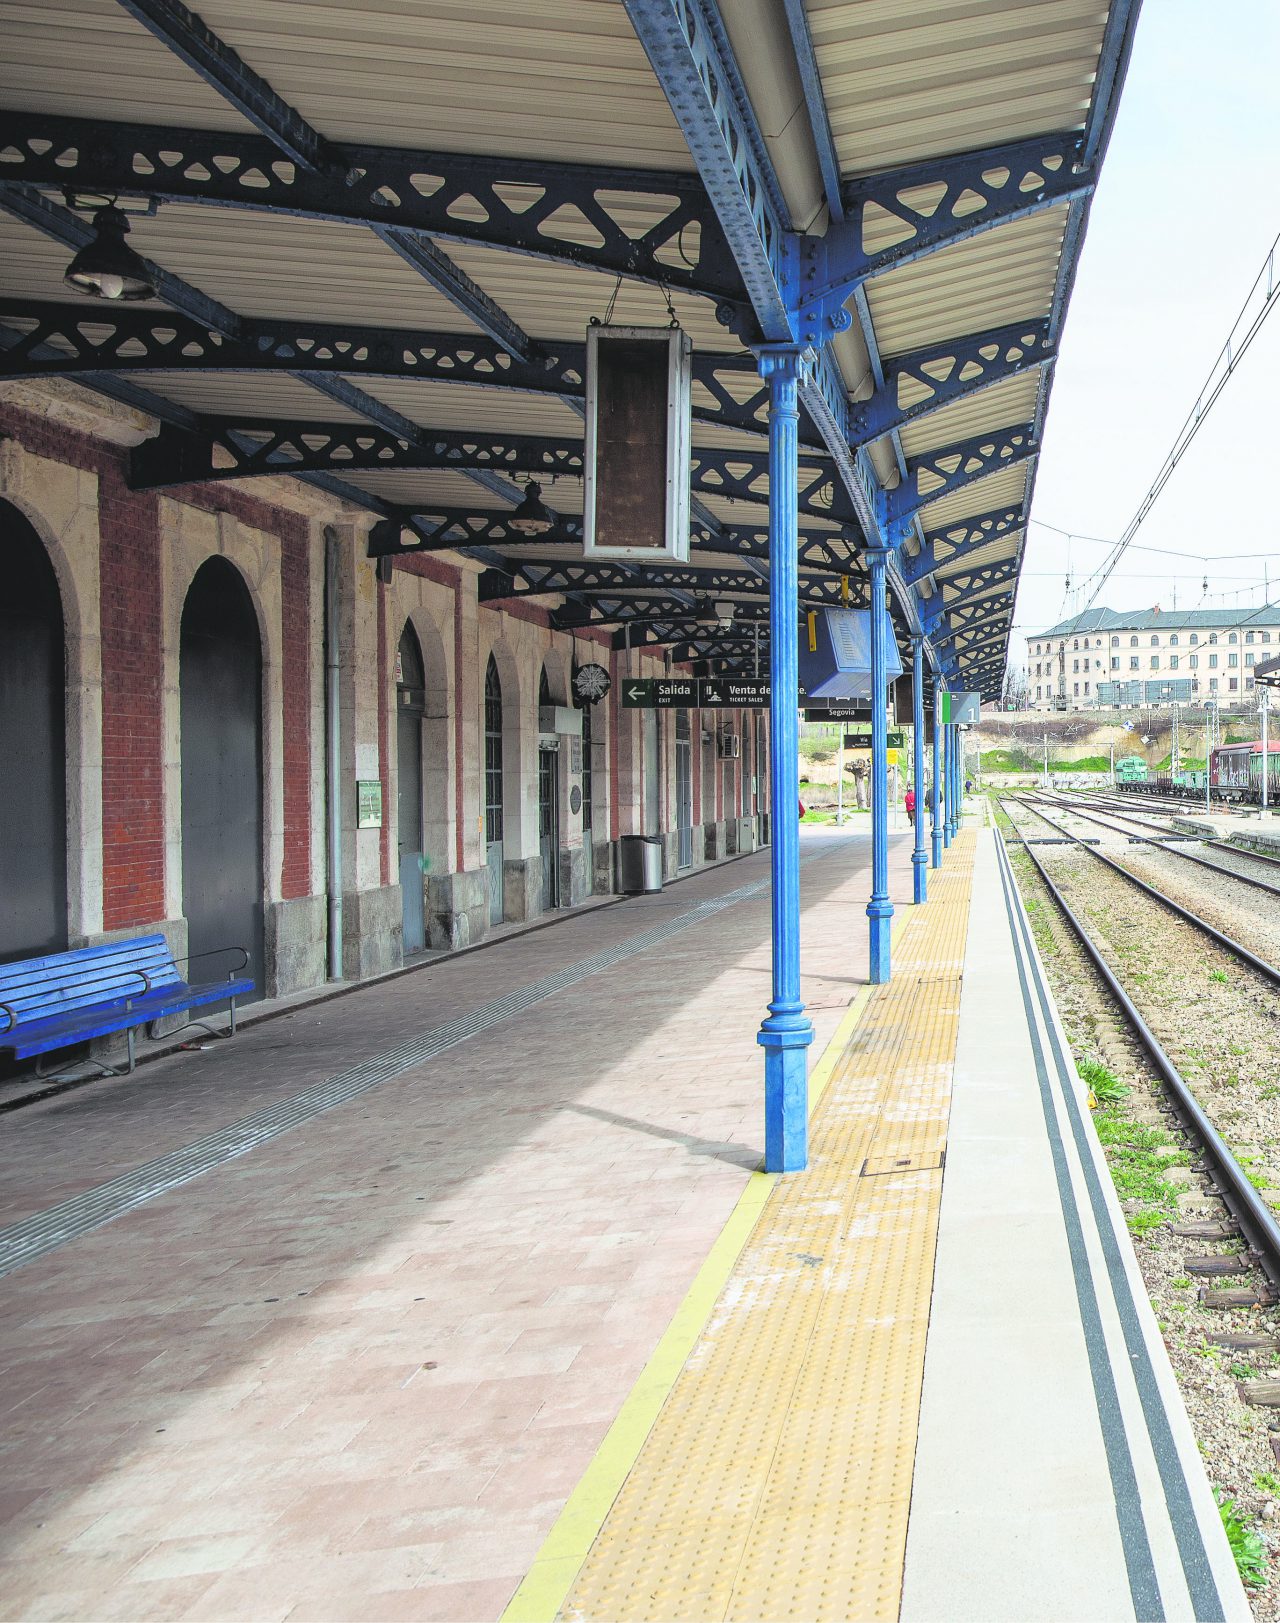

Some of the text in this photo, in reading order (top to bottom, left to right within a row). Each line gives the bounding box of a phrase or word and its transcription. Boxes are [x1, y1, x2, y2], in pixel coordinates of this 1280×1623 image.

[658, 685, 691, 695] Salida
[729, 685, 757, 695] Venta
[828, 709, 856, 718] Segovia
[967, 707, 977, 723] 1
